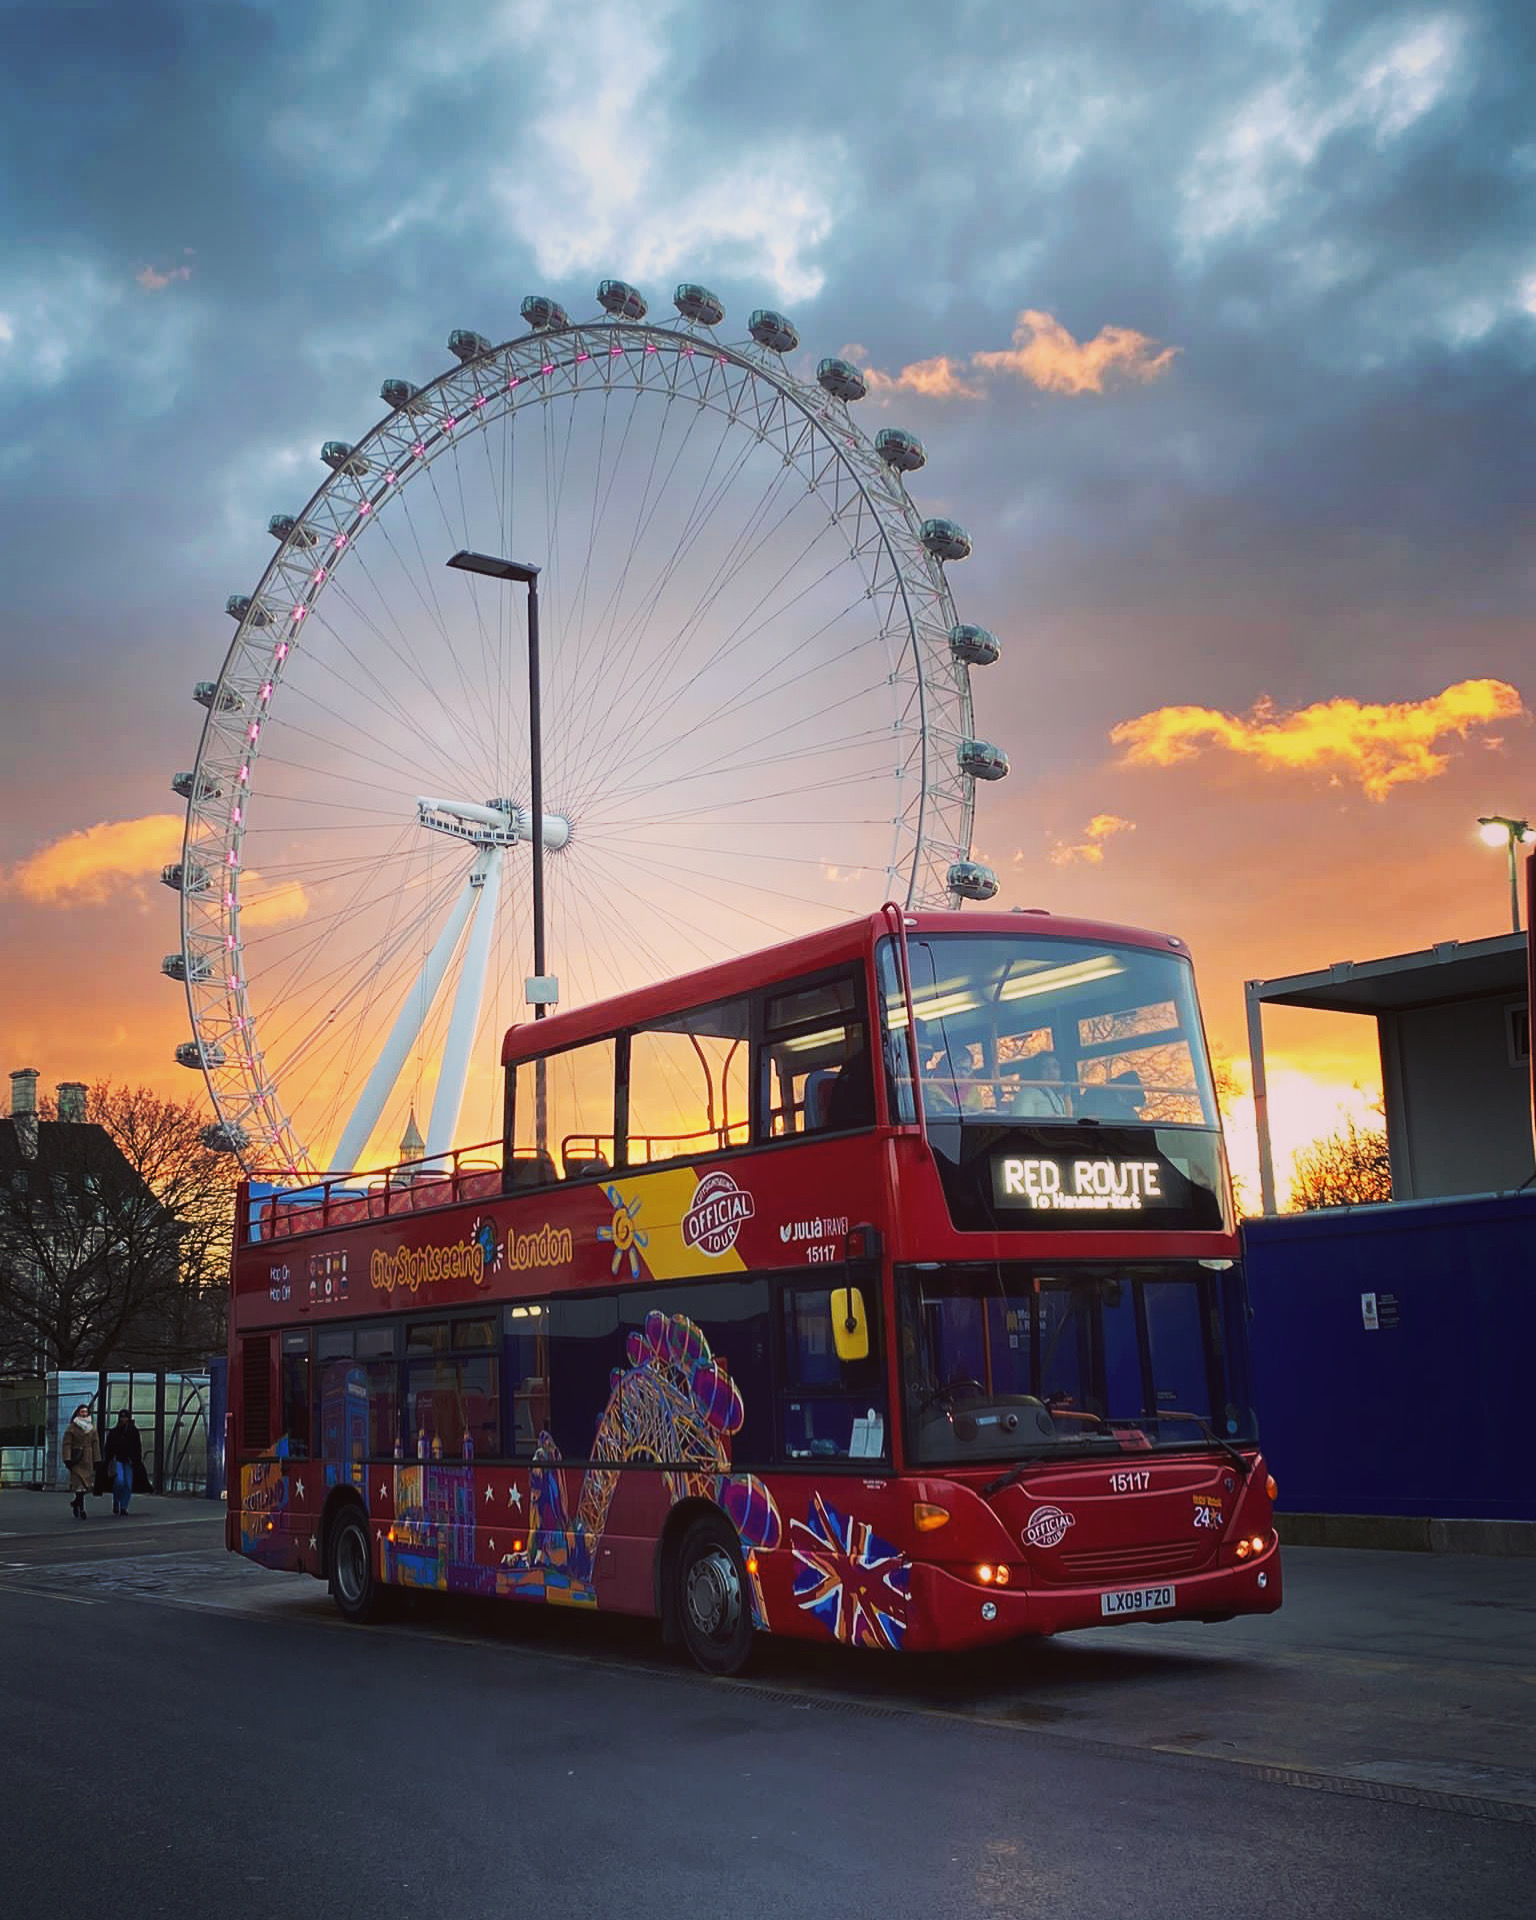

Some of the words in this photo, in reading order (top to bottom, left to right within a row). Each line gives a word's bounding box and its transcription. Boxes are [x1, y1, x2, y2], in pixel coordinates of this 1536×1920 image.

[1003, 1159, 1060, 1194] RED
[1074, 1160, 1160, 1196] ROUTE
[1029, 1192, 1050, 1209] To
[689, 1194, 751, 1239] OFFICIAL
[507, 1222, 573, 1271] London
[708, 1225, 736, 1251] TOUR
[806, 1244, 836, 1263] 15117
[1109, 1471, 1150, 1492] 15117
[1027, 1515, 1074, 1541] OFFICIAL
[1043, 1531, 1062, 1544] TOUR
[1106, 1591, 1142, 1612] LX09
[1145, 1588, 1170, 1607] FZO
